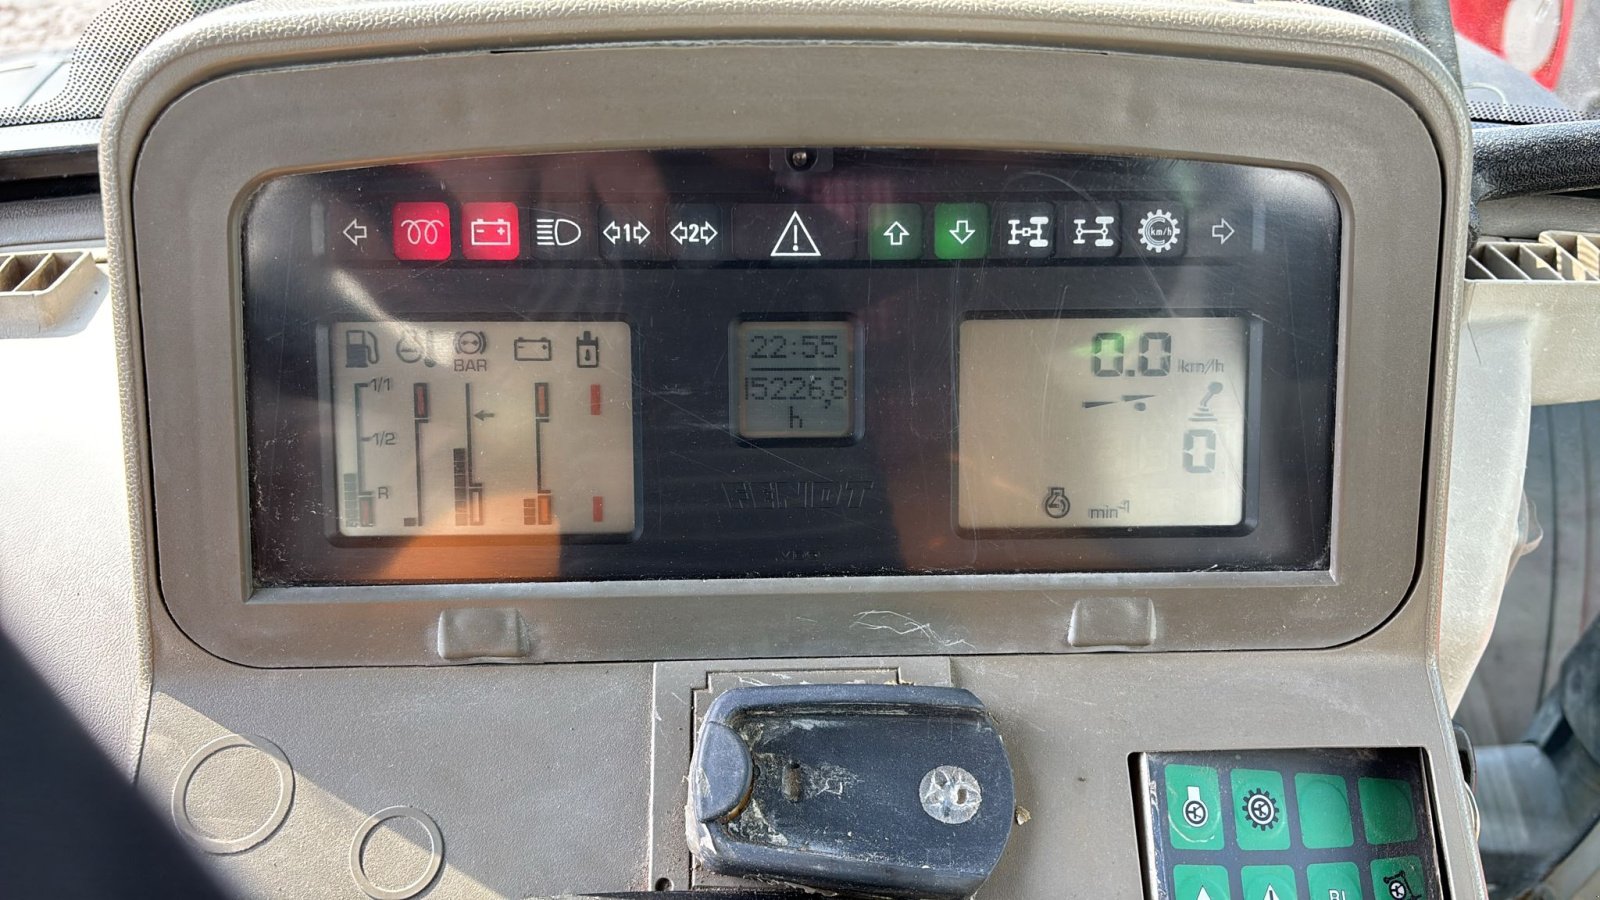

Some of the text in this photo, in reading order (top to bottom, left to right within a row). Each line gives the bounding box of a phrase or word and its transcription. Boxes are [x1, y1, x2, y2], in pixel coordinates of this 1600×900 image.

[623, 223, 631, 242] 1
[688, 223, 700, 242] 2
[1150, 227, 1172, 236] km/h
[751, 335, 838, 358] 22:55
[1092, 332, 1224, 377] 0.0 km/h
[454, 359, 487, 371] BAR
[370, 377, 392, 391] 1/1
[789, 406, 803, 428] h
[373, 432, 396, 446] 1/2
[1183, 429, 1216, 473] 0
[378, 487, 389, 499] R
